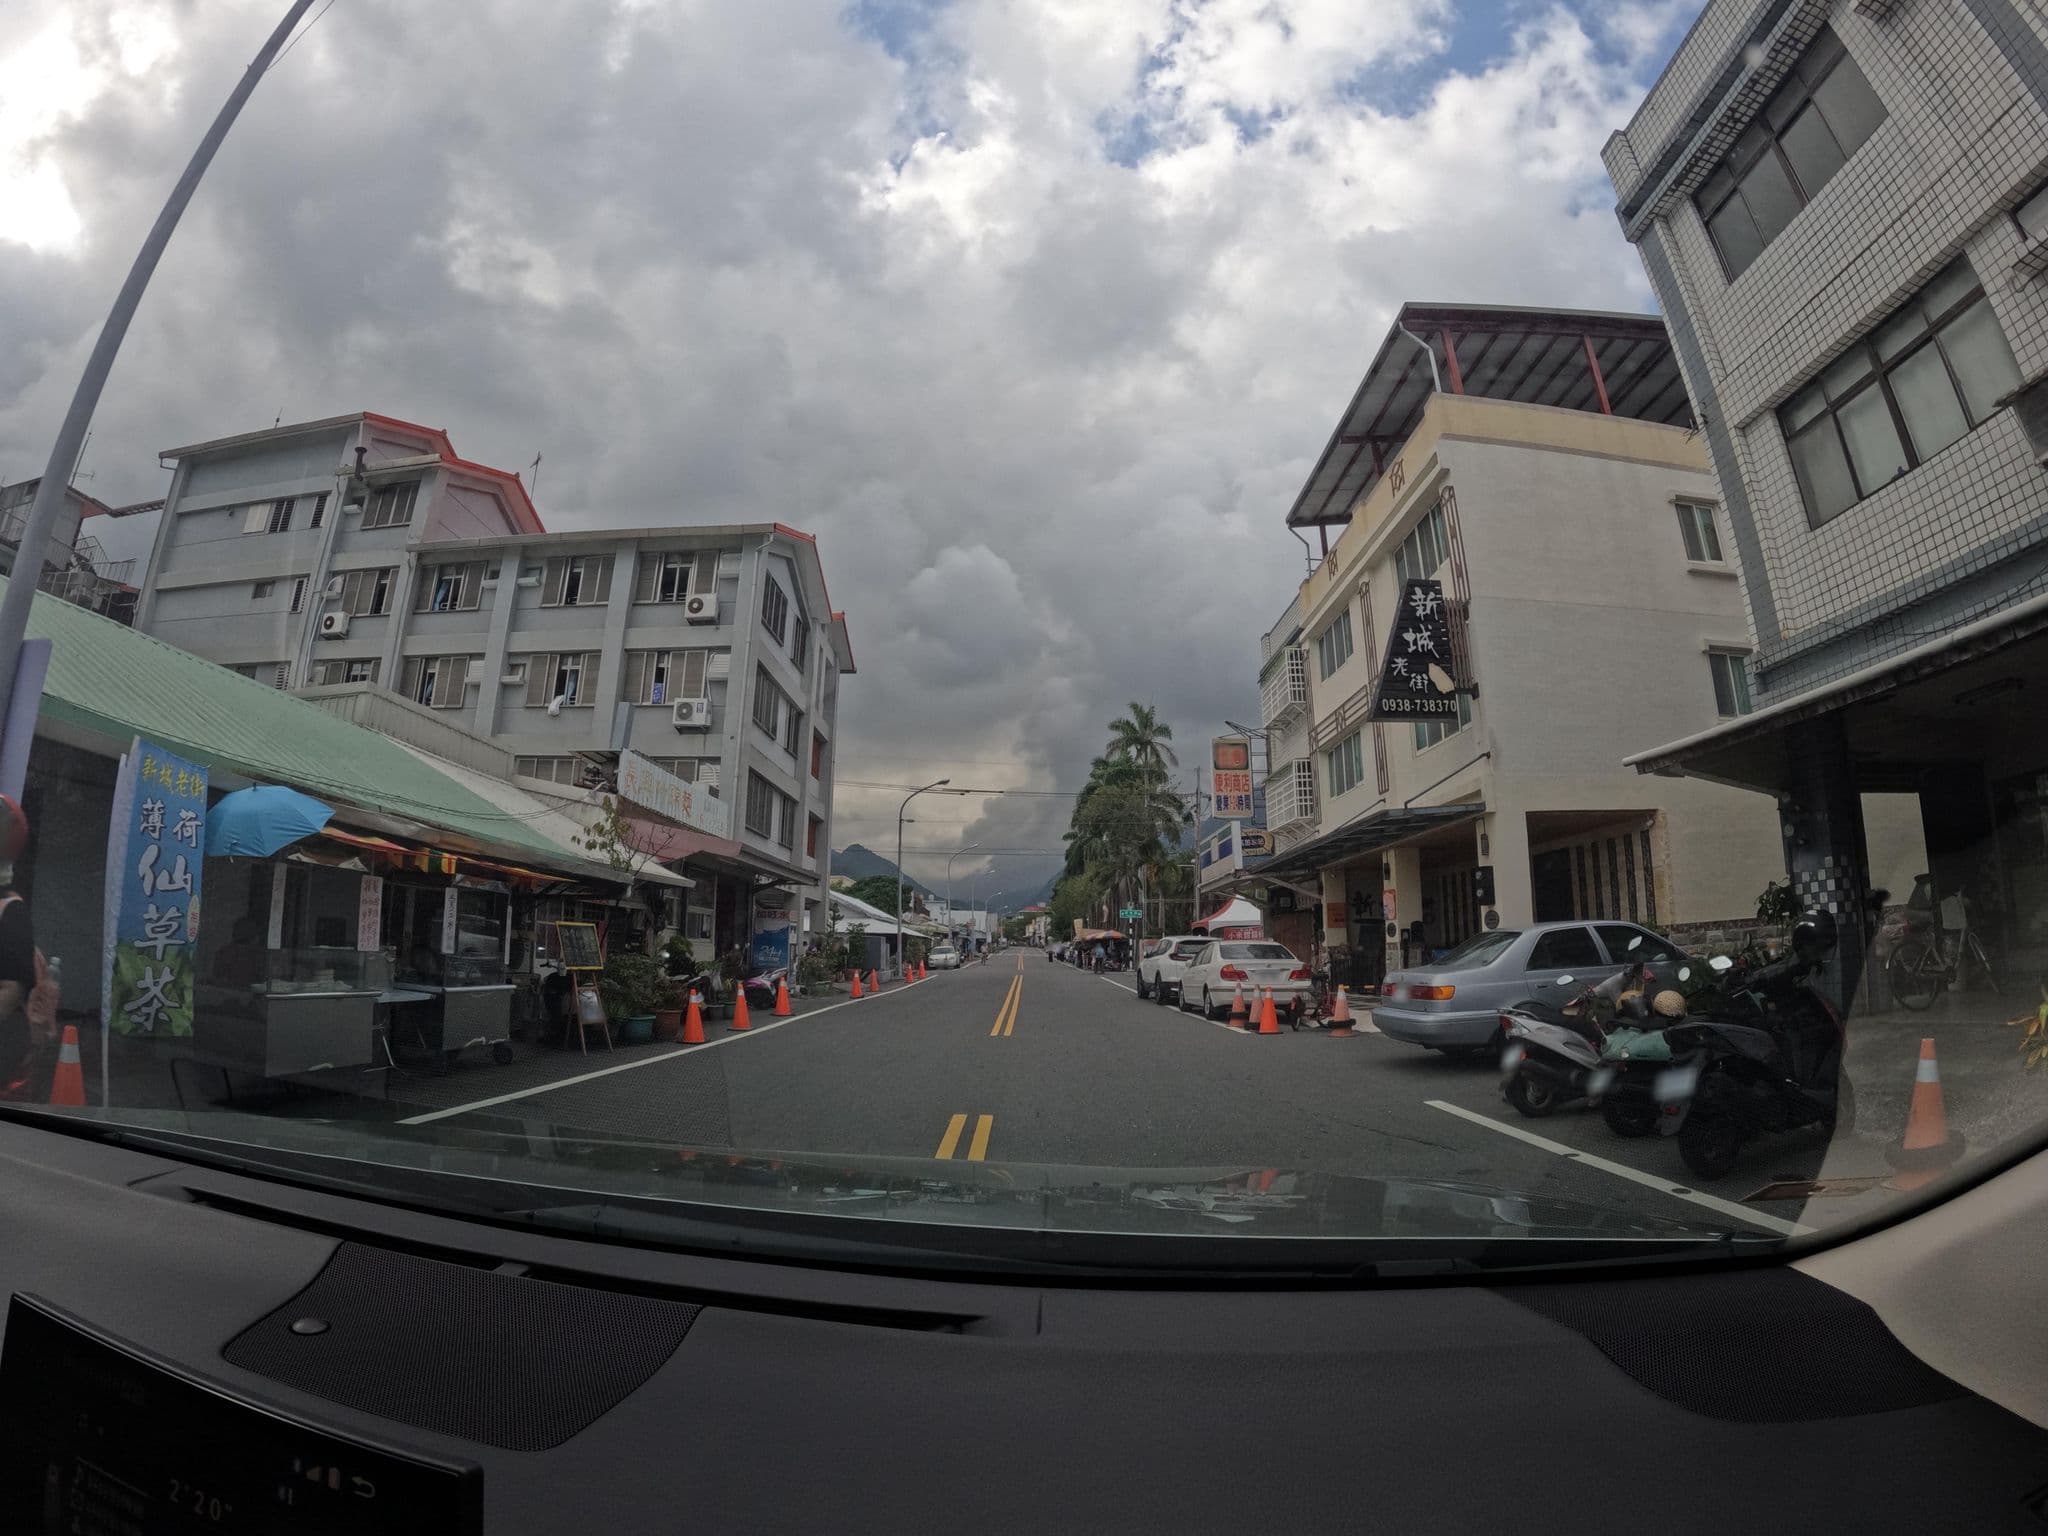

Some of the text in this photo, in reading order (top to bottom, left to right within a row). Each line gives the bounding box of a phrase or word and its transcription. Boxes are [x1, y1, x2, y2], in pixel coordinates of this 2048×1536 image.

[1382, 698, 1457, 713] 0938-738370
[142, 754, 205, 801] 新城老街
[1215, 771, 1250, 793] 便利商店
[123, 843, 192, 1032] 仙草茶
